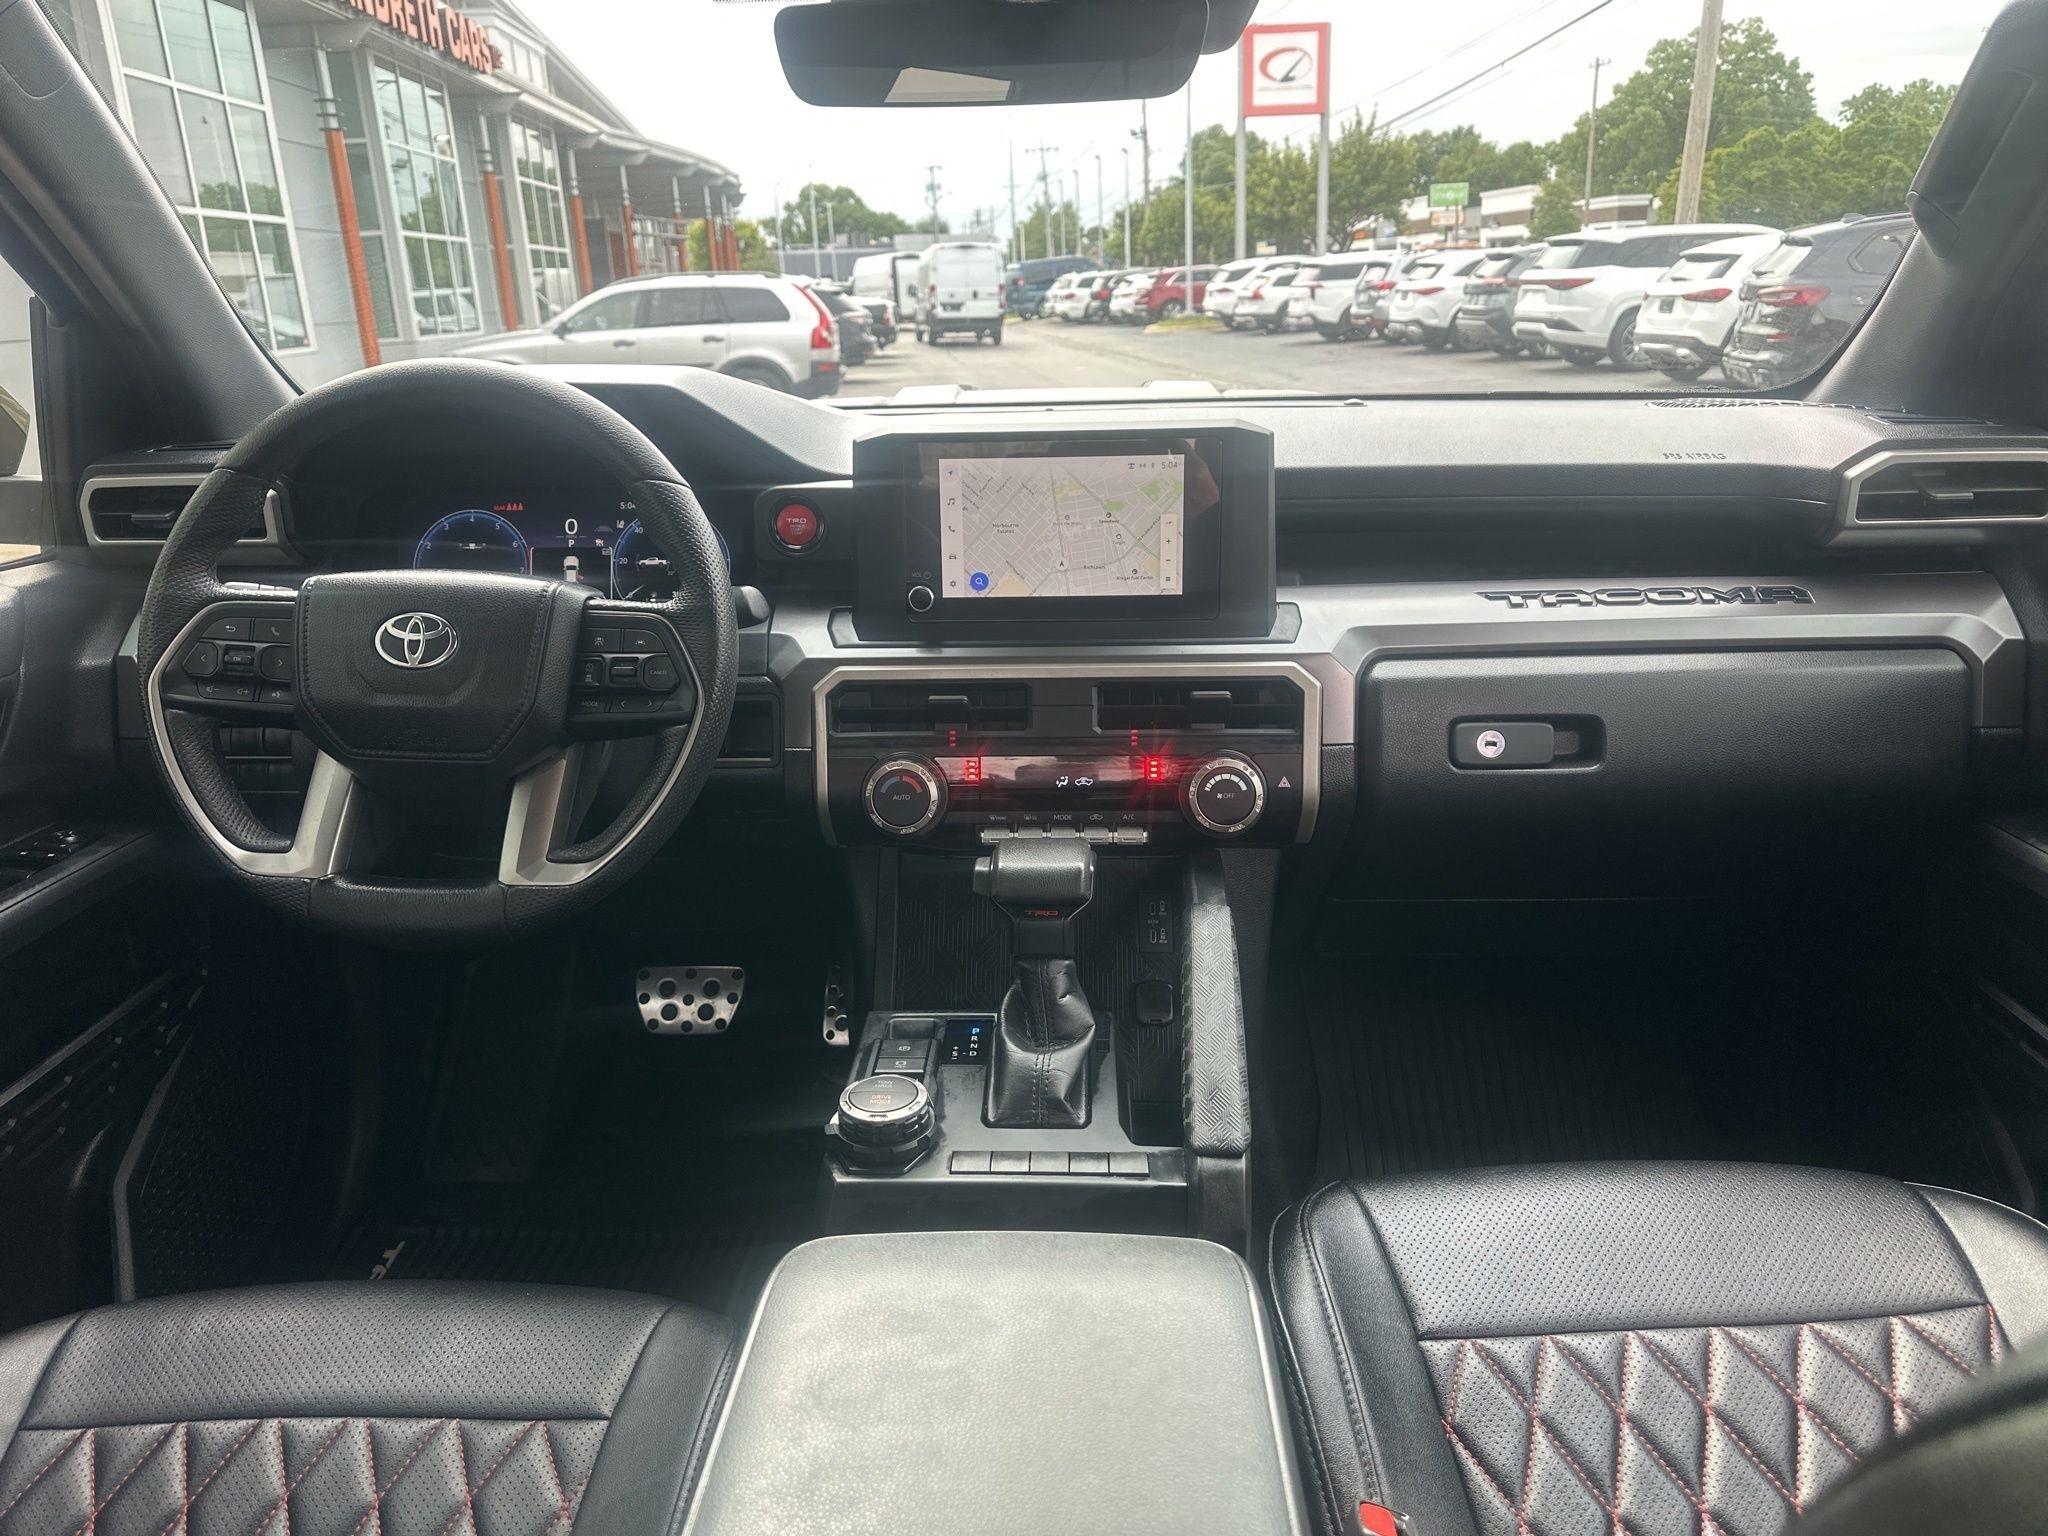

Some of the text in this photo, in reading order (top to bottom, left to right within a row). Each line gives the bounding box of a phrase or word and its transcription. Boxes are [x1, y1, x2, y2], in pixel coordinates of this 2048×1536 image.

[350, 0, 493, 75] RETH CARS
[564, 518, 578, 535] 0
[568, 539, 575, 548] P
[619, 557, 628, 565] 20
[1473, 584, 1816, 608] TACOMA
[971, 1027, 980, 1035] P
